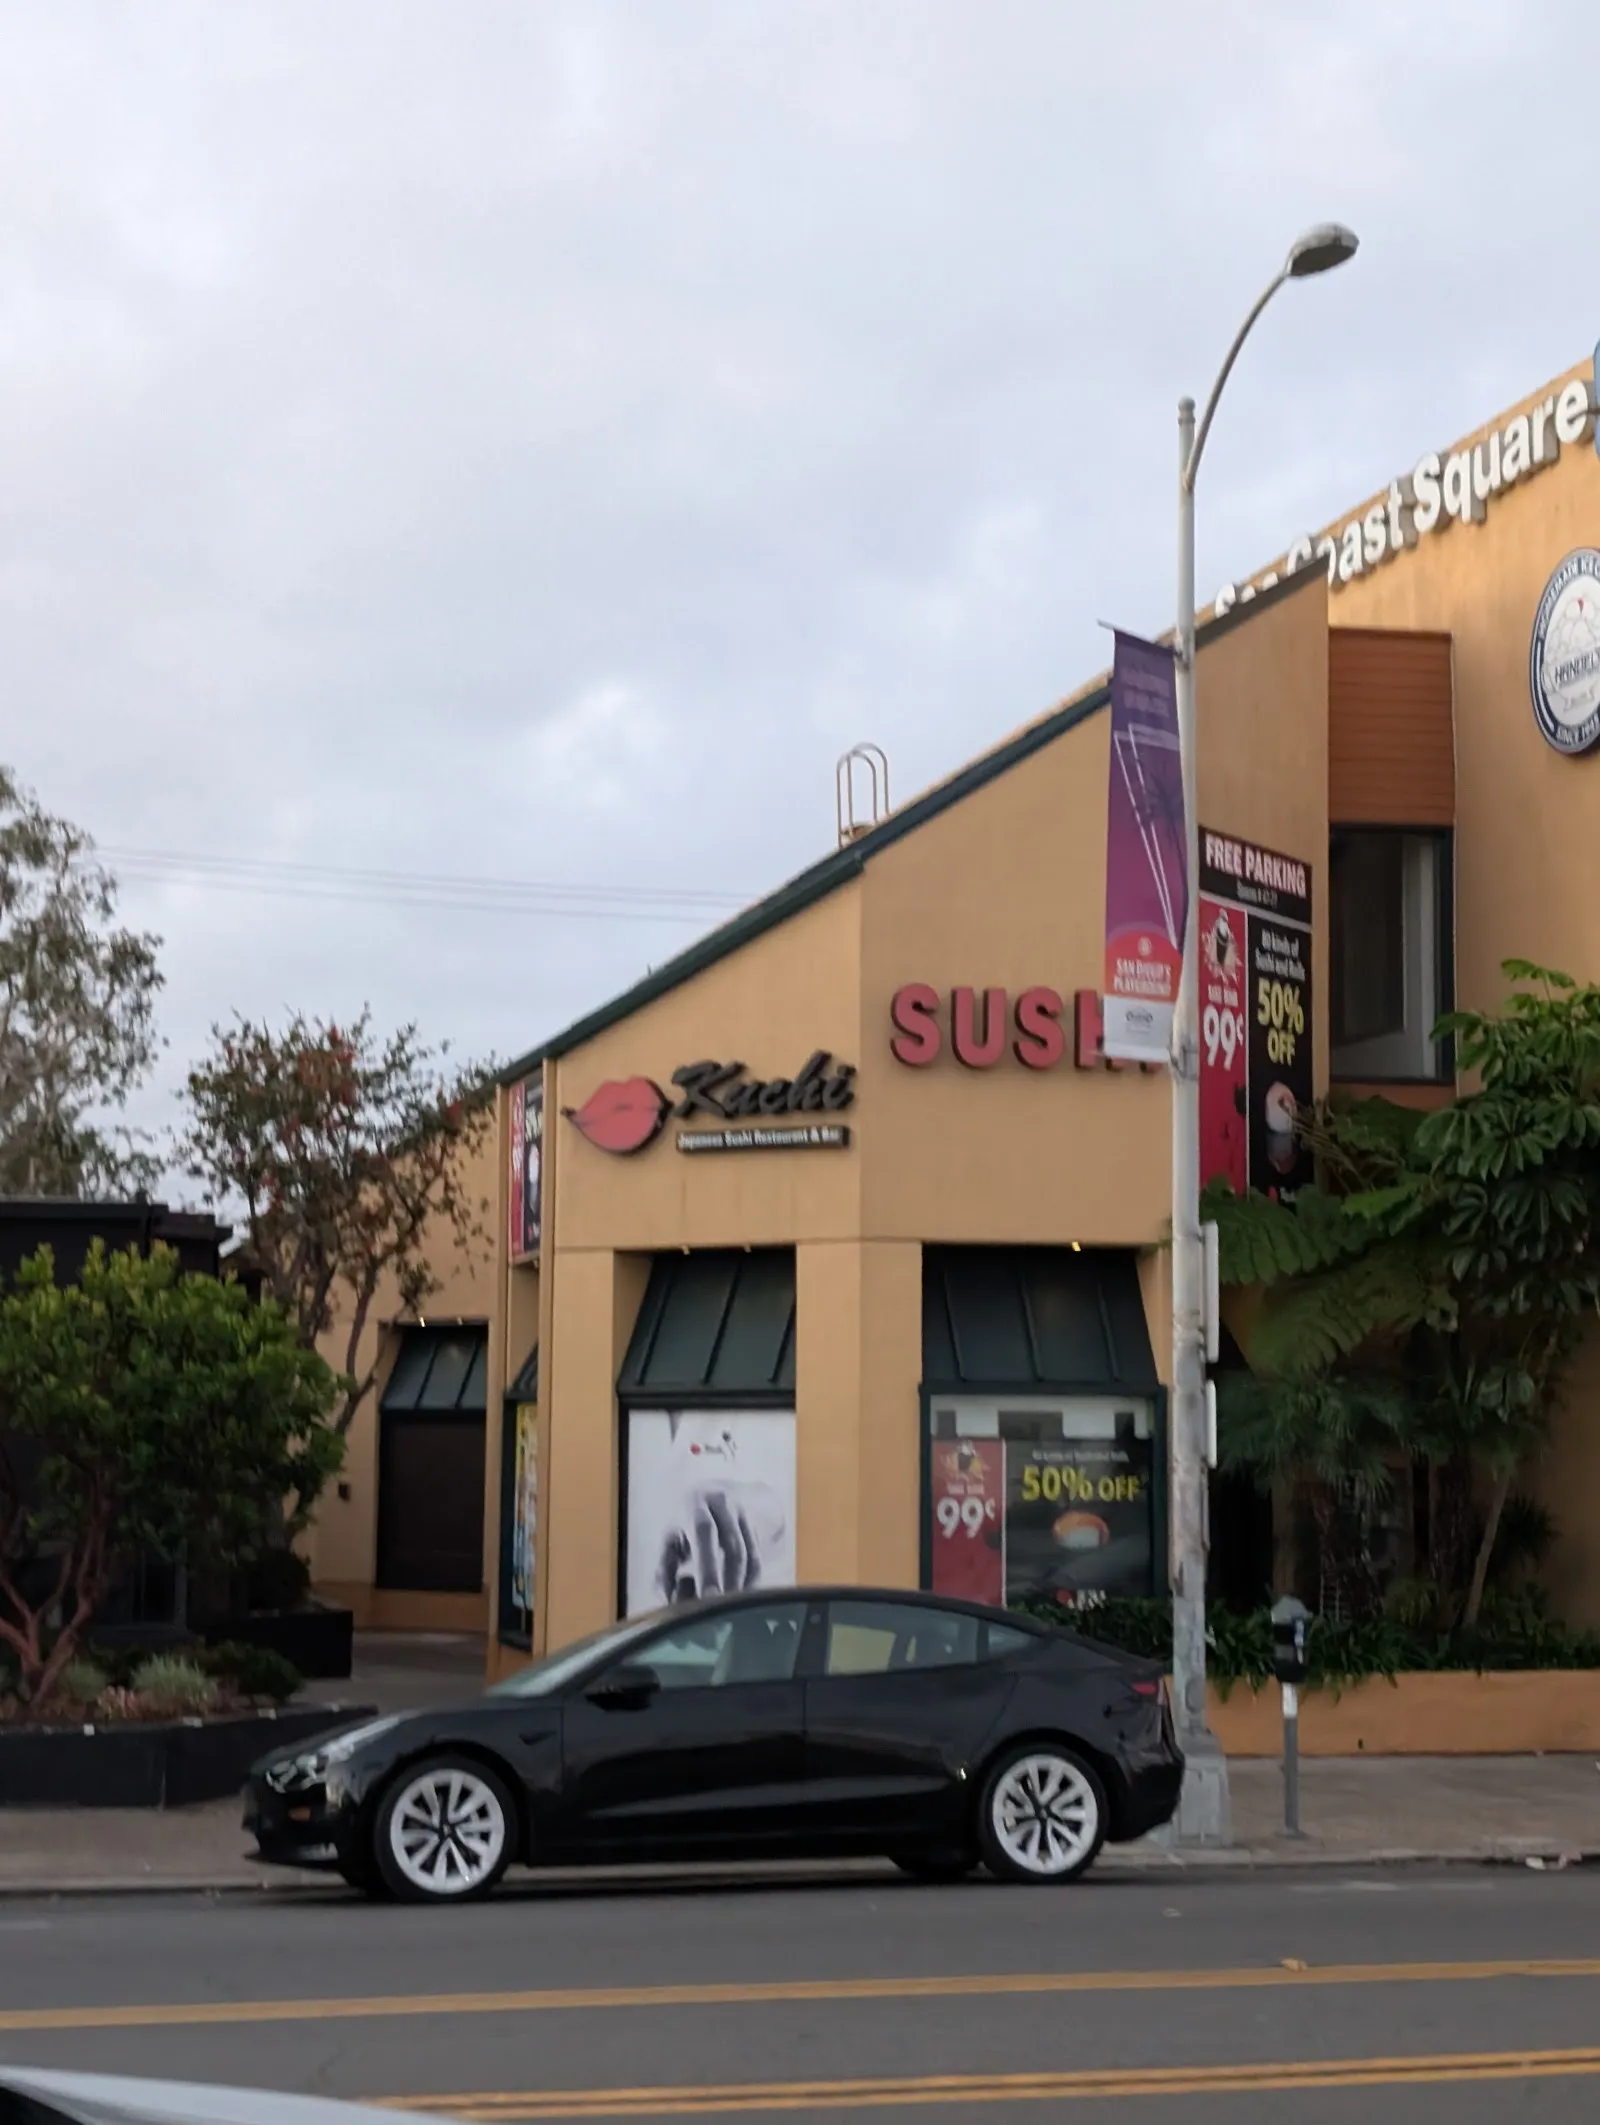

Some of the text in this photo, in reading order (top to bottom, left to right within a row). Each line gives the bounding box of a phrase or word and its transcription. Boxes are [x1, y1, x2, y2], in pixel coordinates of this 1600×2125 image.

[1412, 378, 1589, 534] Square
[1205, 832, 1243, 879] FREE
[1245, 845, 1306, 899] PARKING
[891, 983, 1168, 1071] SUSH
[1257, 977, 1305, 1036] 50%
[1267, 1027, 1296, 1068] OFF
[671, 1050, 857, 1120] Kuchi
[724, 1129, 752, 1148] Sushi
[754, 1127, 809, 1146] Restaurant
[1022, 1464, 1094, 1502] 50%
[1098, 1474, 1140, 1503] OFF
